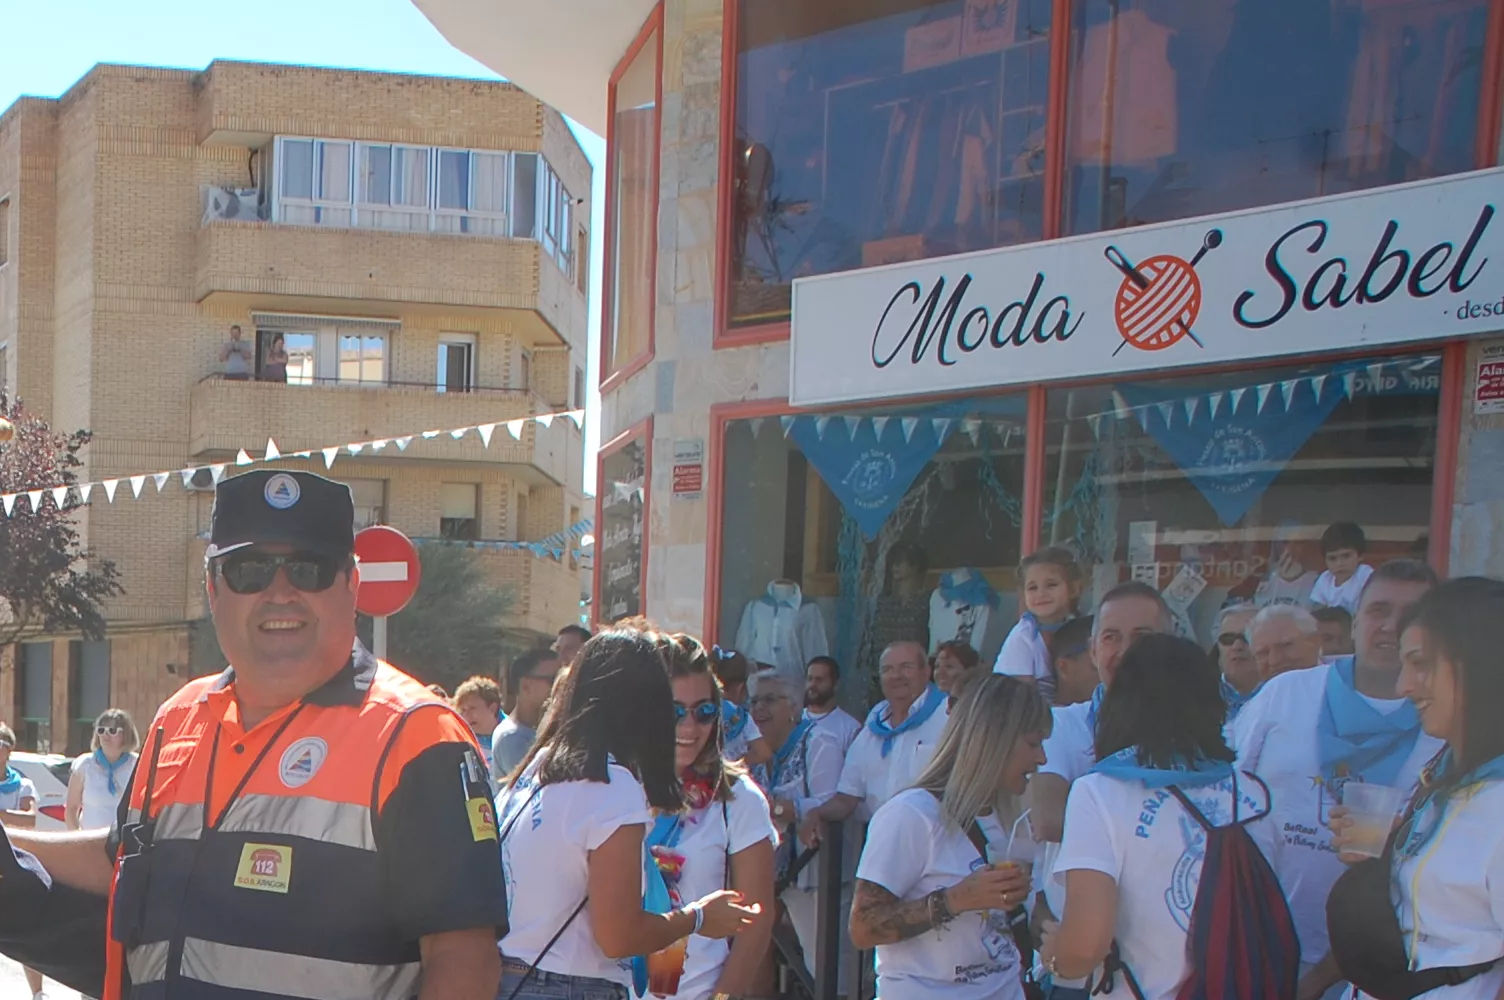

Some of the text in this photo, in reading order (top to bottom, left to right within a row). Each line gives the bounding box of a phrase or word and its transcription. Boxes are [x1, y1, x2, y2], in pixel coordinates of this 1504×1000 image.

[871, 203, 1495, 368] Moda Sabel
[255, 859, 275, 874] 112
